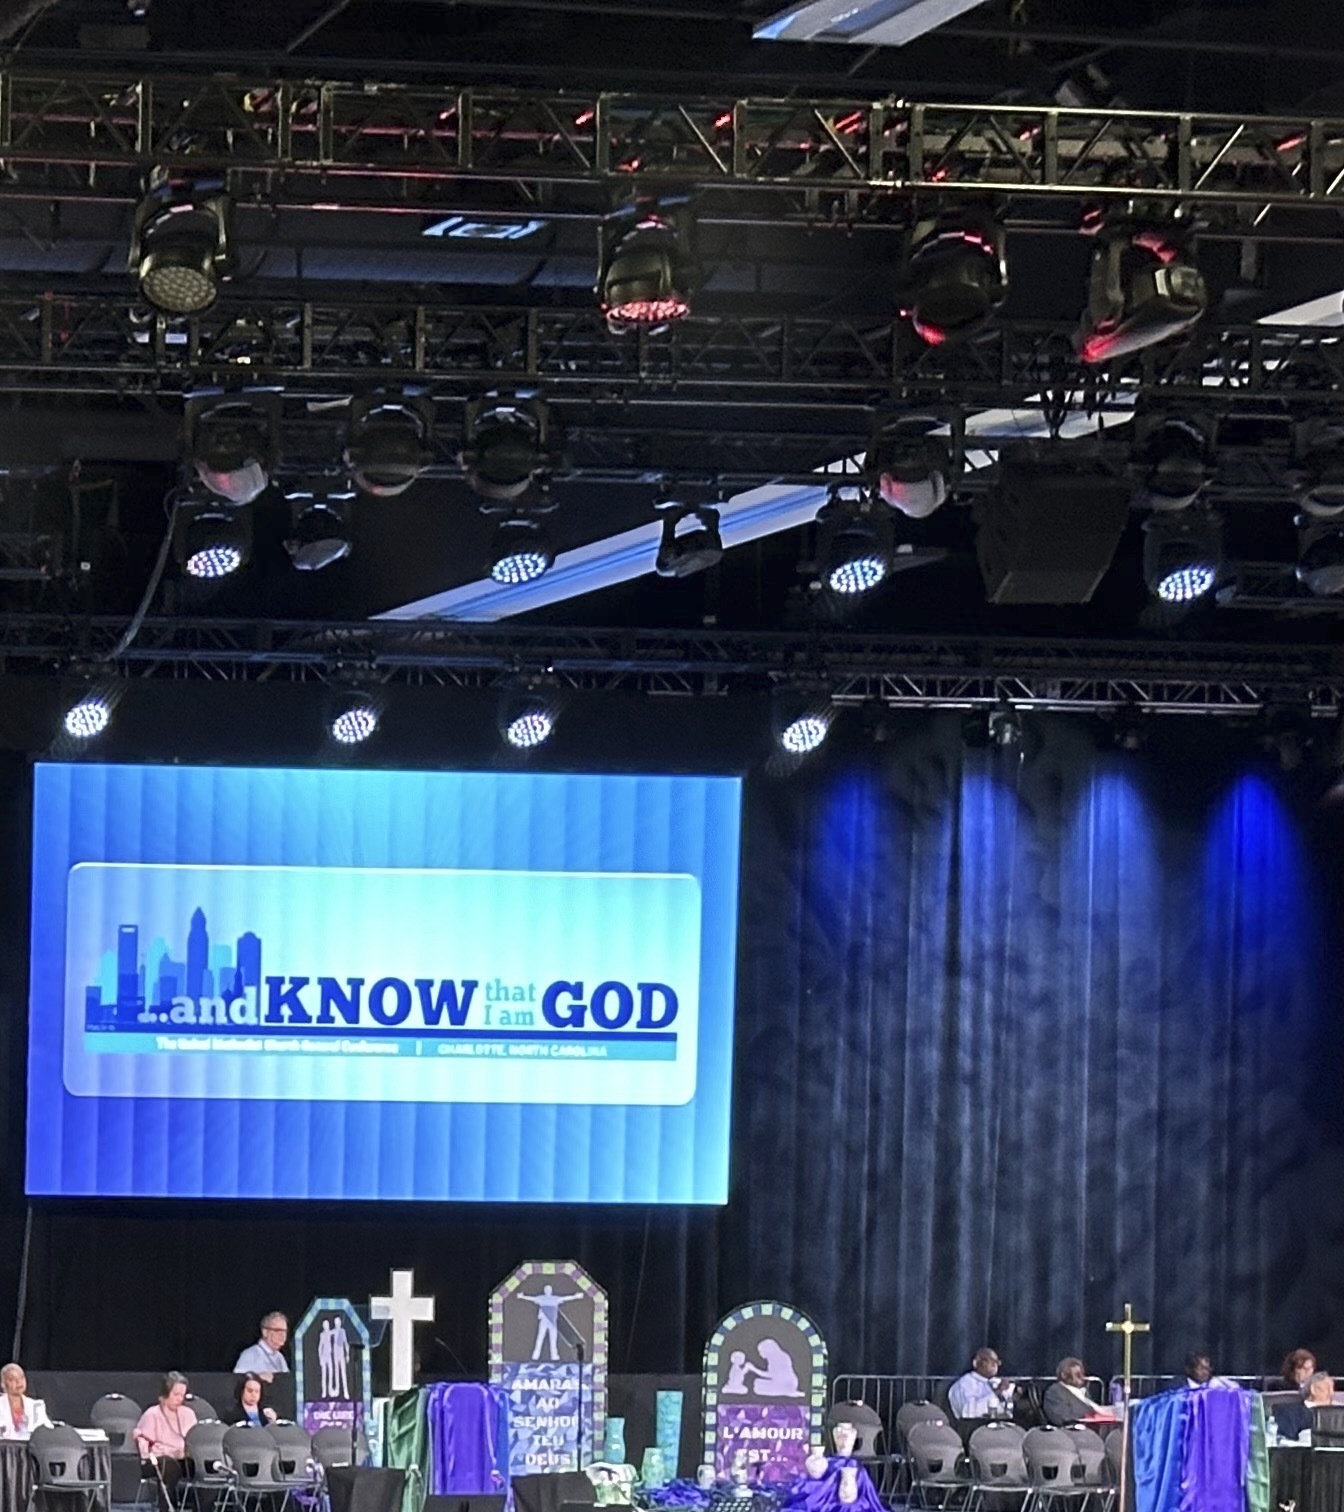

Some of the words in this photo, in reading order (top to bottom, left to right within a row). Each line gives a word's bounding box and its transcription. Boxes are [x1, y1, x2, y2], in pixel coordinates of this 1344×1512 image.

[485, 978, 536, 1002] that
[264, 976, 479, 1027] KNOW
[542, 980, 679, 1029] GOD
[483, 1005, 493, 1026] I
[499, 1009, 535, 1026] am
[723, 1426, 803, 1440] L'AMOUR
[525, 1453, 571, 1465] DEUS
